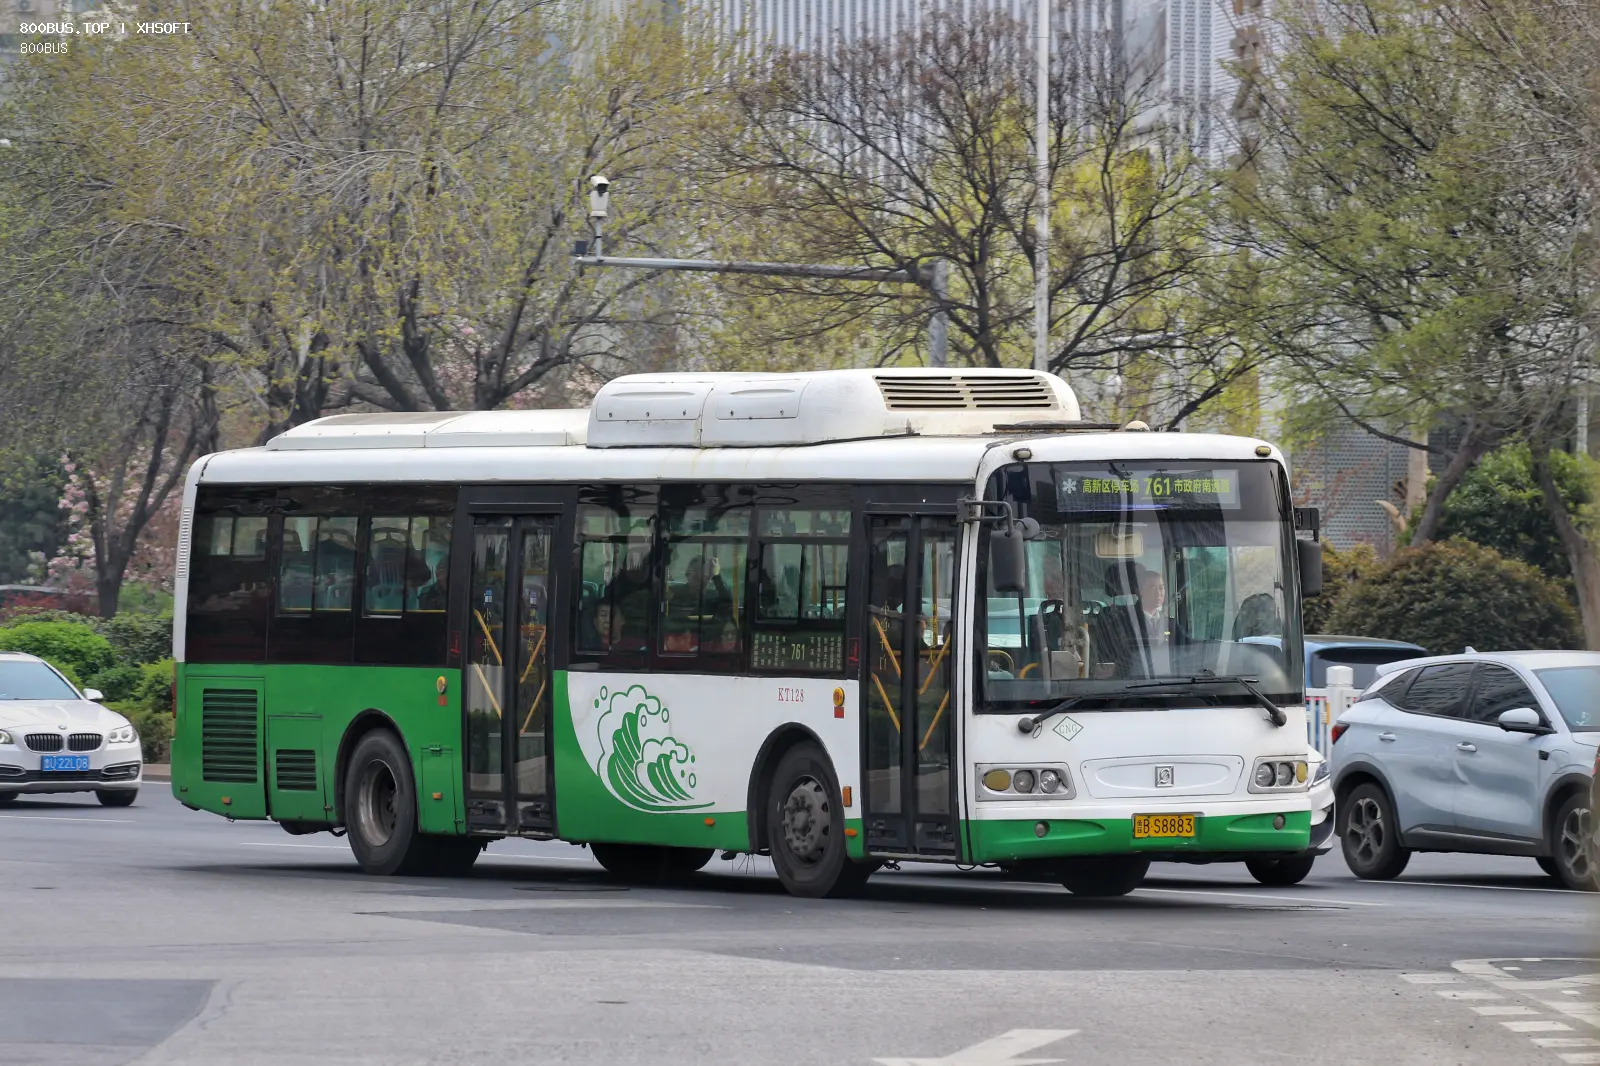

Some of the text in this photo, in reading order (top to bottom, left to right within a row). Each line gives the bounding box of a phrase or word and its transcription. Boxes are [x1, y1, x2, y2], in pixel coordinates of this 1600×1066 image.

[1082, 478, 1140, 494] 高新区停车场
[1144, 477, 1171, 496] 761
[791, 643, 806, 660] 761
[777, 687, 805, 702] KT128
